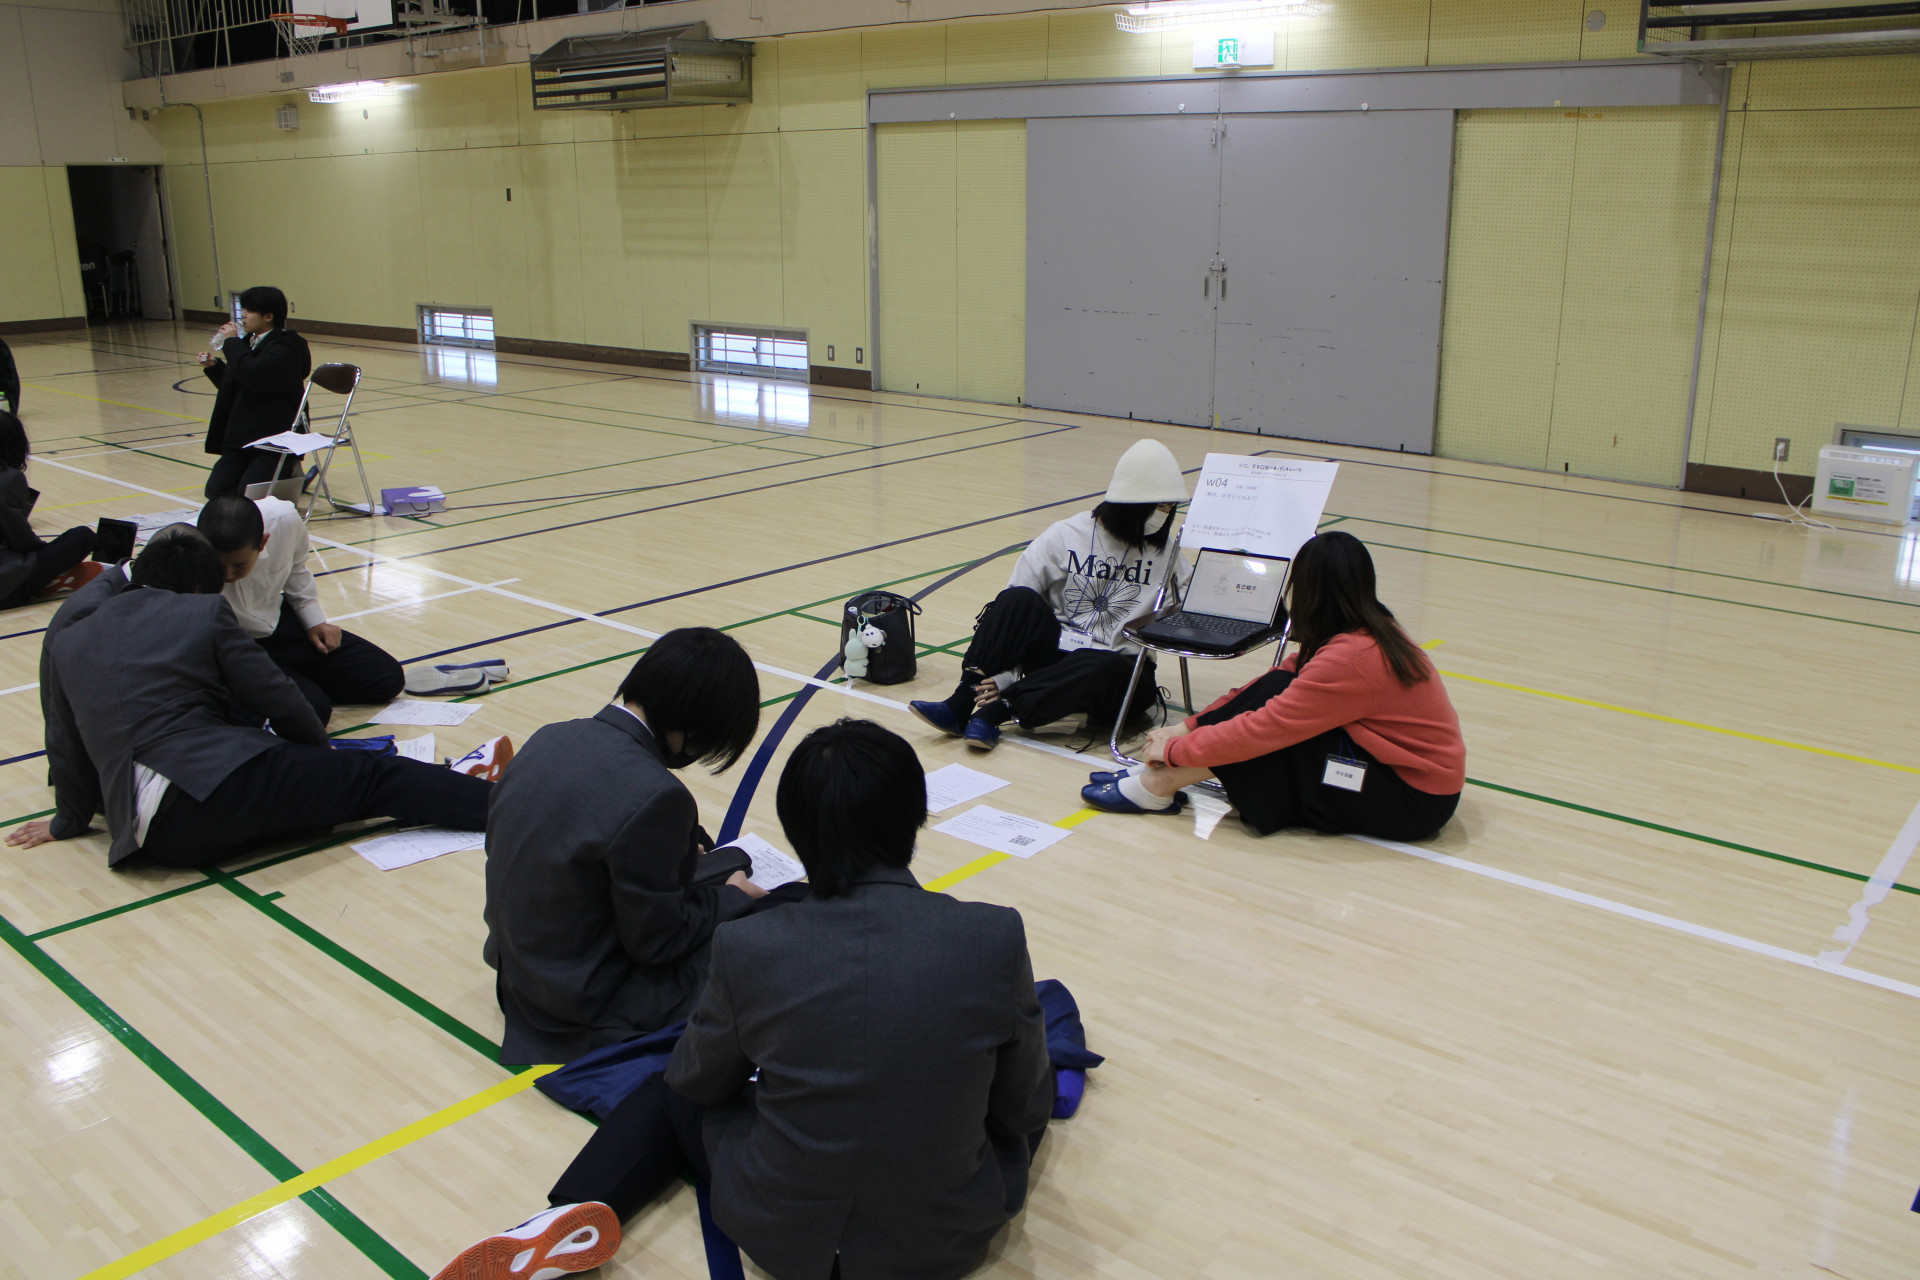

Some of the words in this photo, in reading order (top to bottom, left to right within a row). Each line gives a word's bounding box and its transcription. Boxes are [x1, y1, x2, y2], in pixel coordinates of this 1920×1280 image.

[1067, 549, 1153, 586] Mardi
[1235, 583, 1257, 591] 自己紹介
